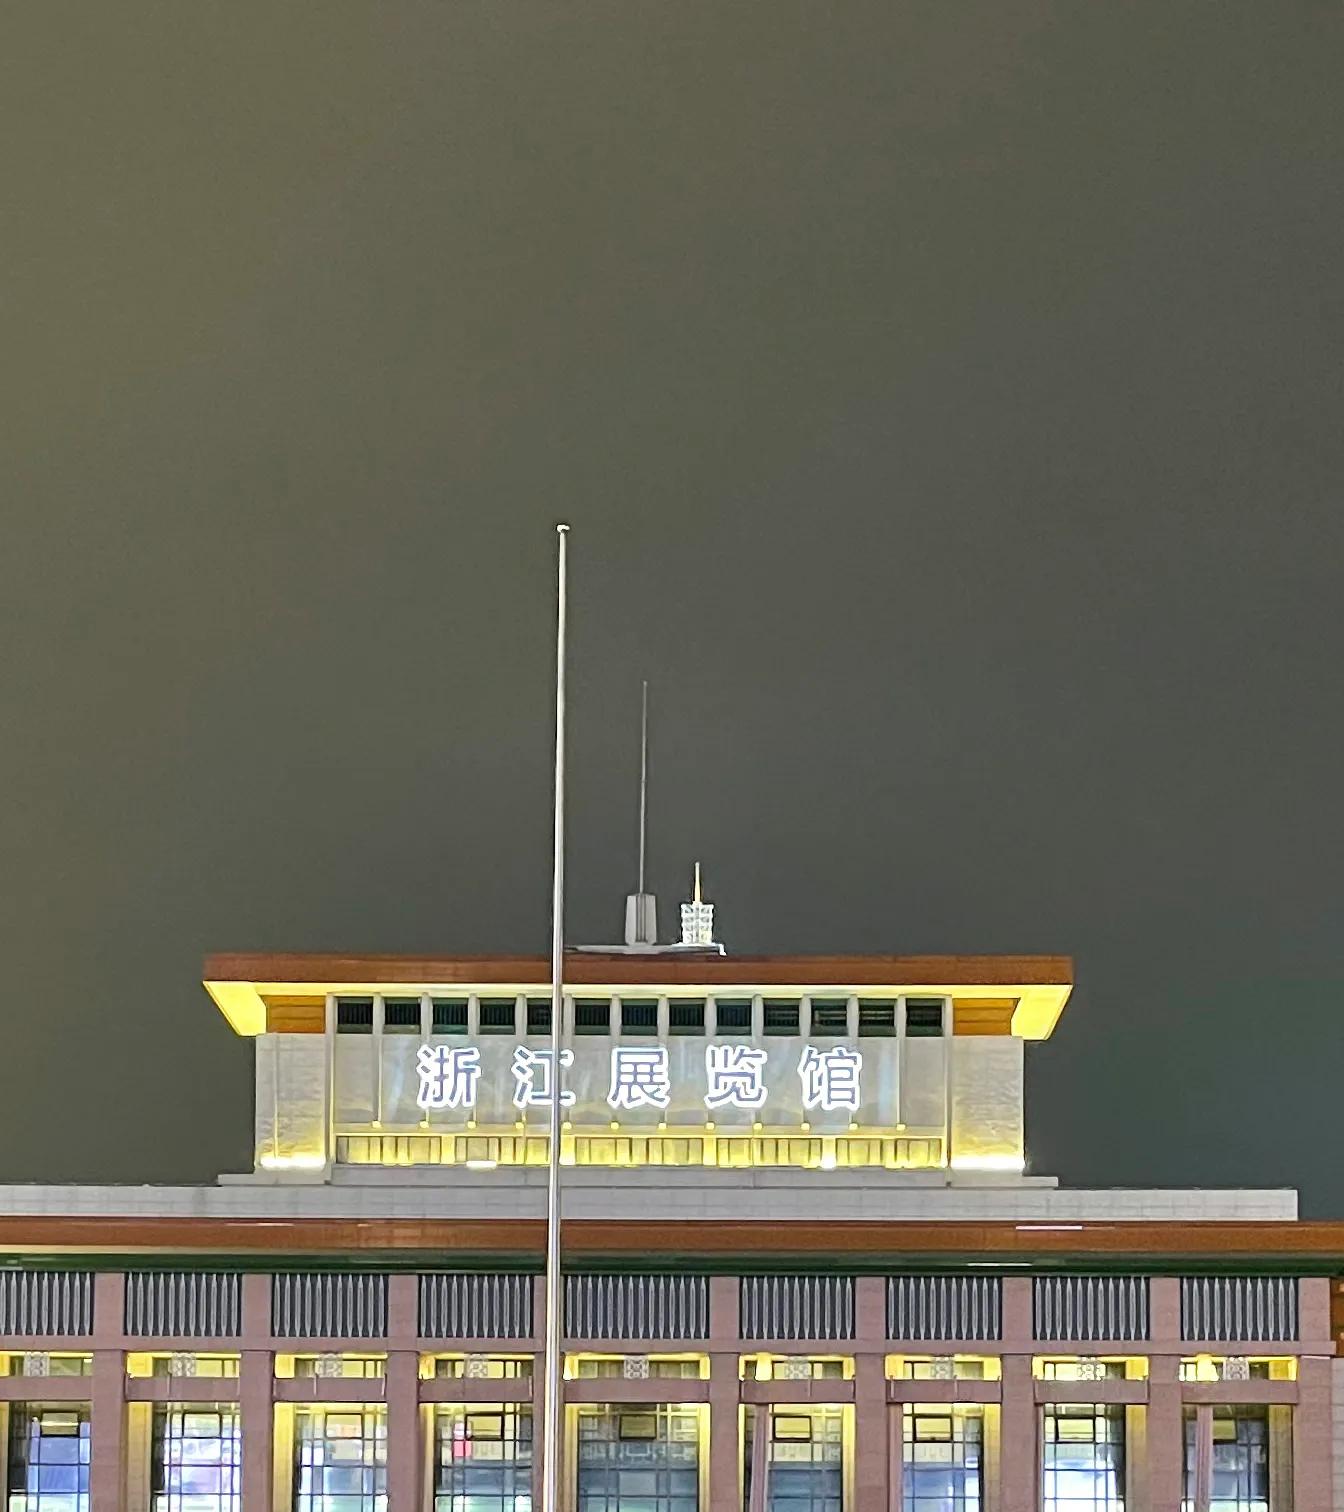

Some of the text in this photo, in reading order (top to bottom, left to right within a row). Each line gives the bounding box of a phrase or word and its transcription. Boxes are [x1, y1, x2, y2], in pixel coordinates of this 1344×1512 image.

[416, 1044, 863, 1110] 浙江展览馆
